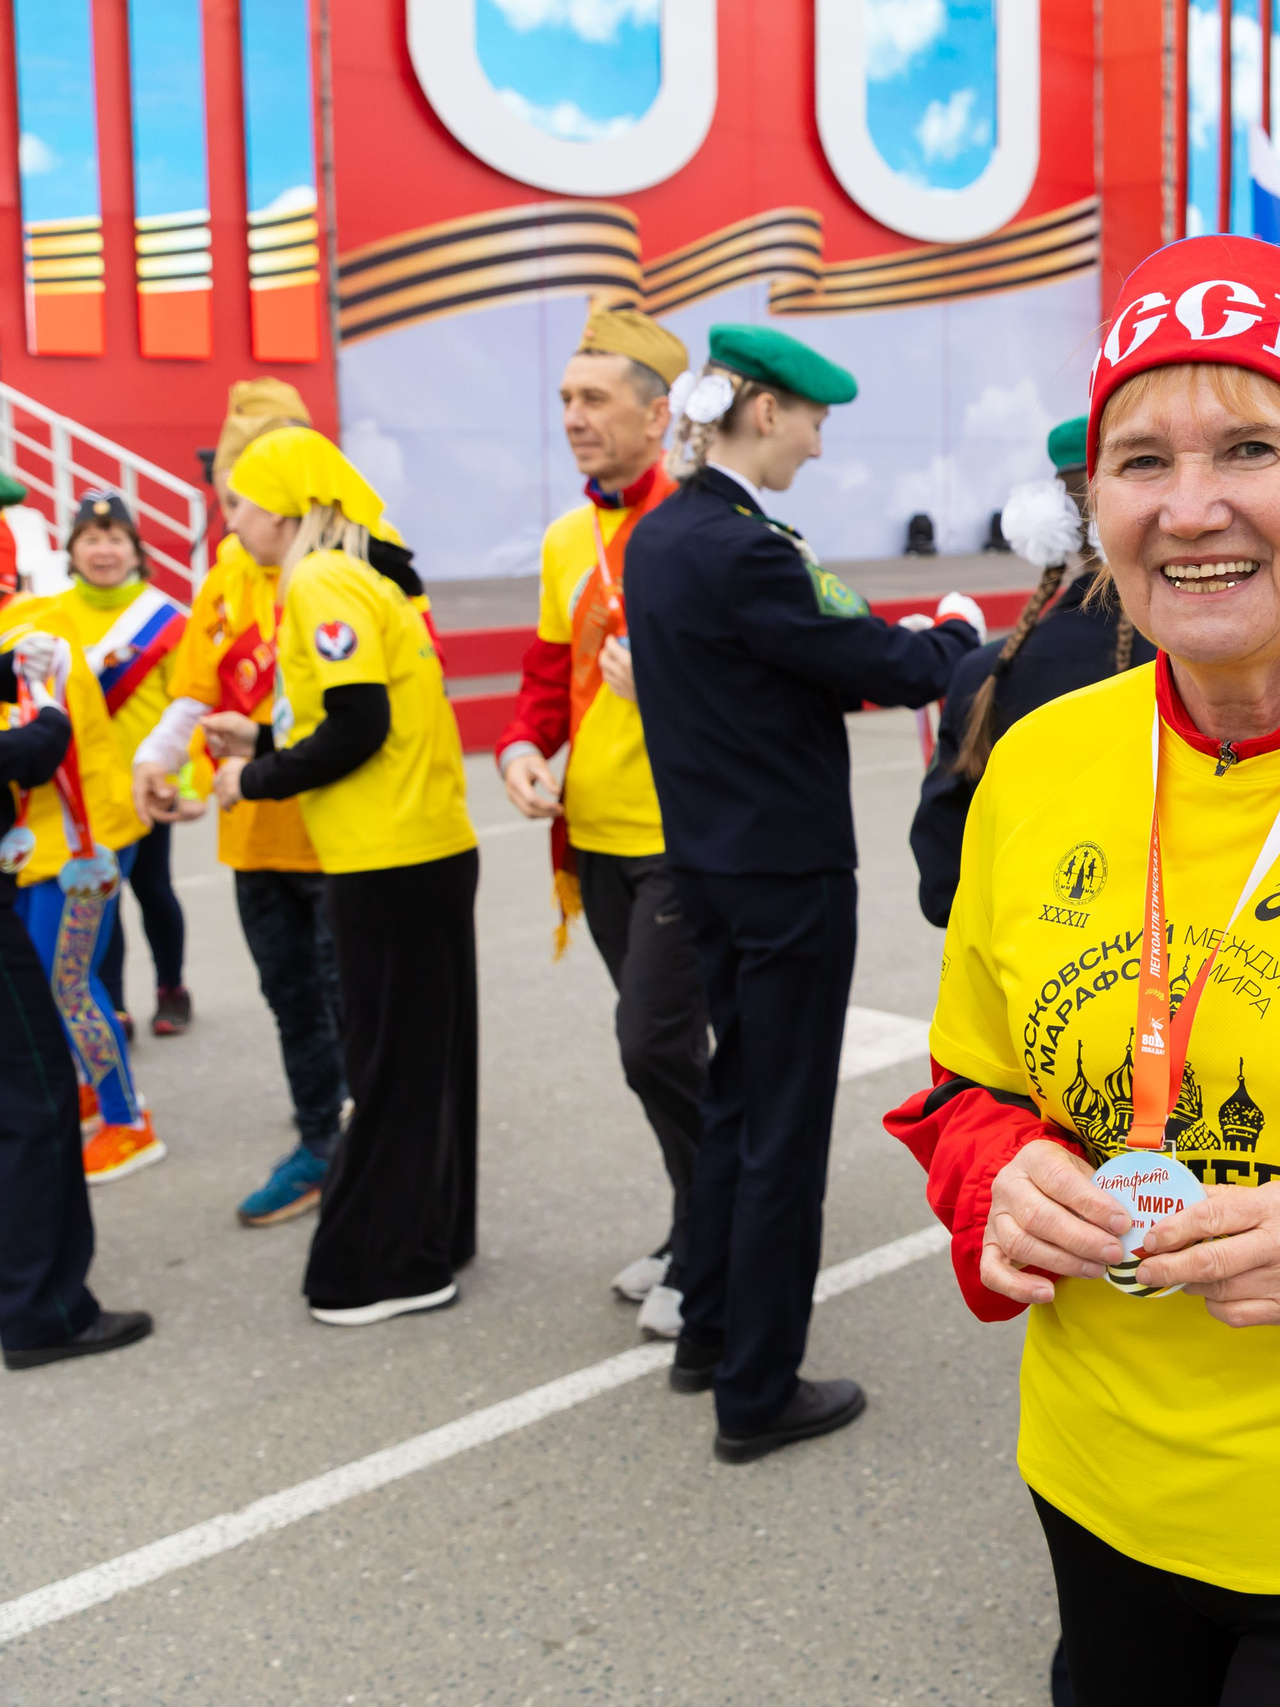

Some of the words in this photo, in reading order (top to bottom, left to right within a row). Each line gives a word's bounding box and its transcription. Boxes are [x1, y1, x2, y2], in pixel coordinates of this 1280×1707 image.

[1038, 904, 1090, 928] XXXII
[1149, 848, 1162, 979] ЛЕГКОАТЛЕТИЧЕСКАЯ
[1040, 952, 1171, 1077] МАРАФО
[1096, 1167, 1171, 1202] Эстафета
[1137, 1194, 1185, 1215] МИРА
